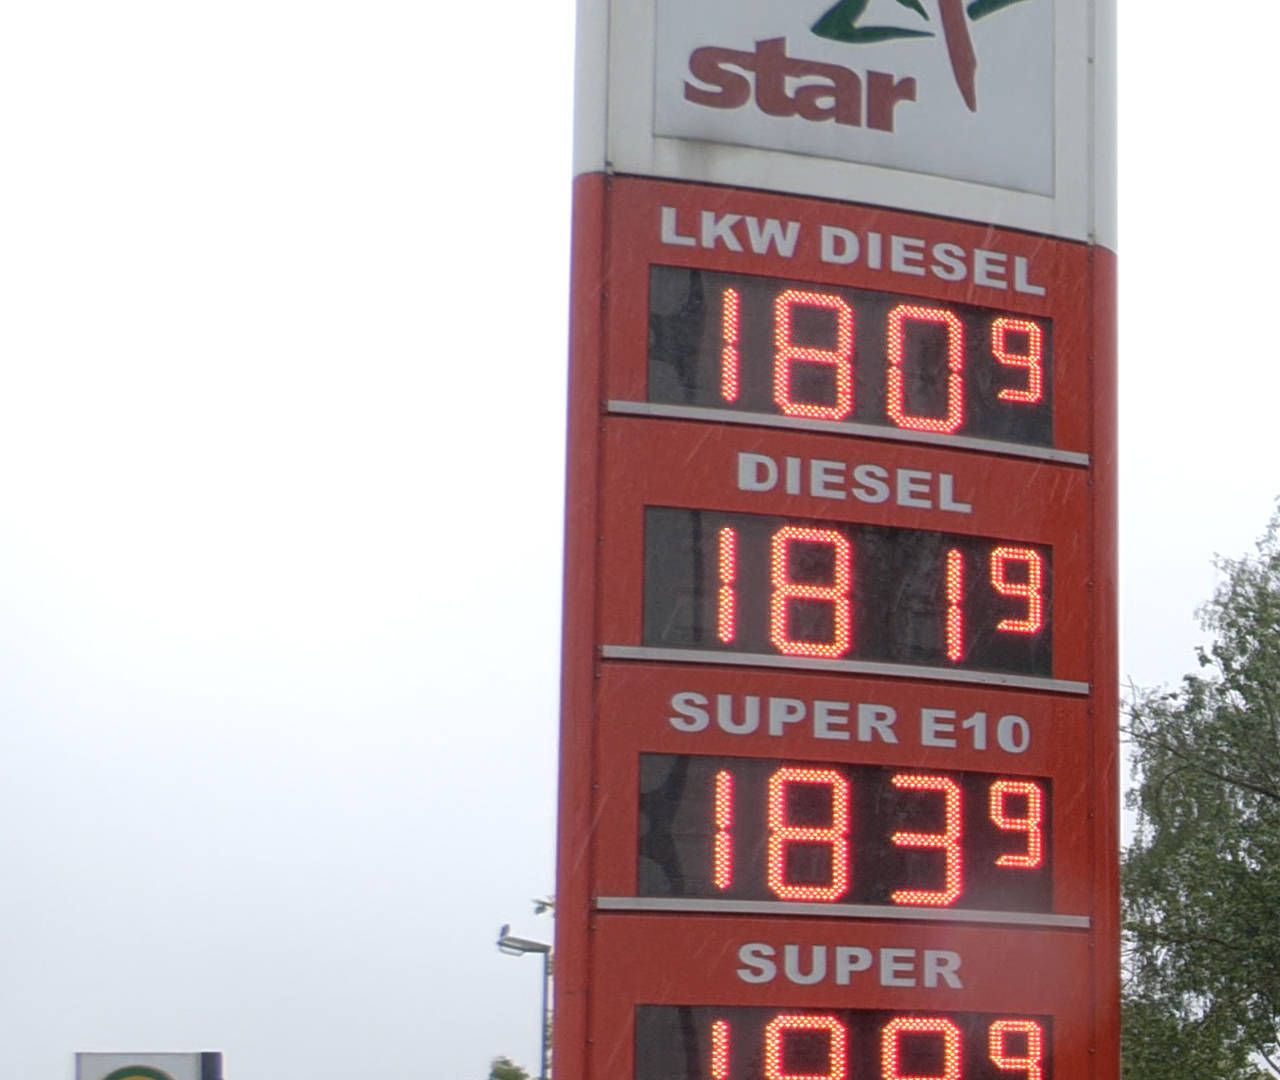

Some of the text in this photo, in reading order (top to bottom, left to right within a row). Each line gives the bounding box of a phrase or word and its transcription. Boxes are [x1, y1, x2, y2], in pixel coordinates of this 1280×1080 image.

[683, 36, 917, 133] star
[660, 206, 1046, 296] LKW DIESEL
[737, 452, 972, 514] DIESEL
[669, 691, 1031, 754] SUPER E10
[736, 942, 963, 990] SUPER
